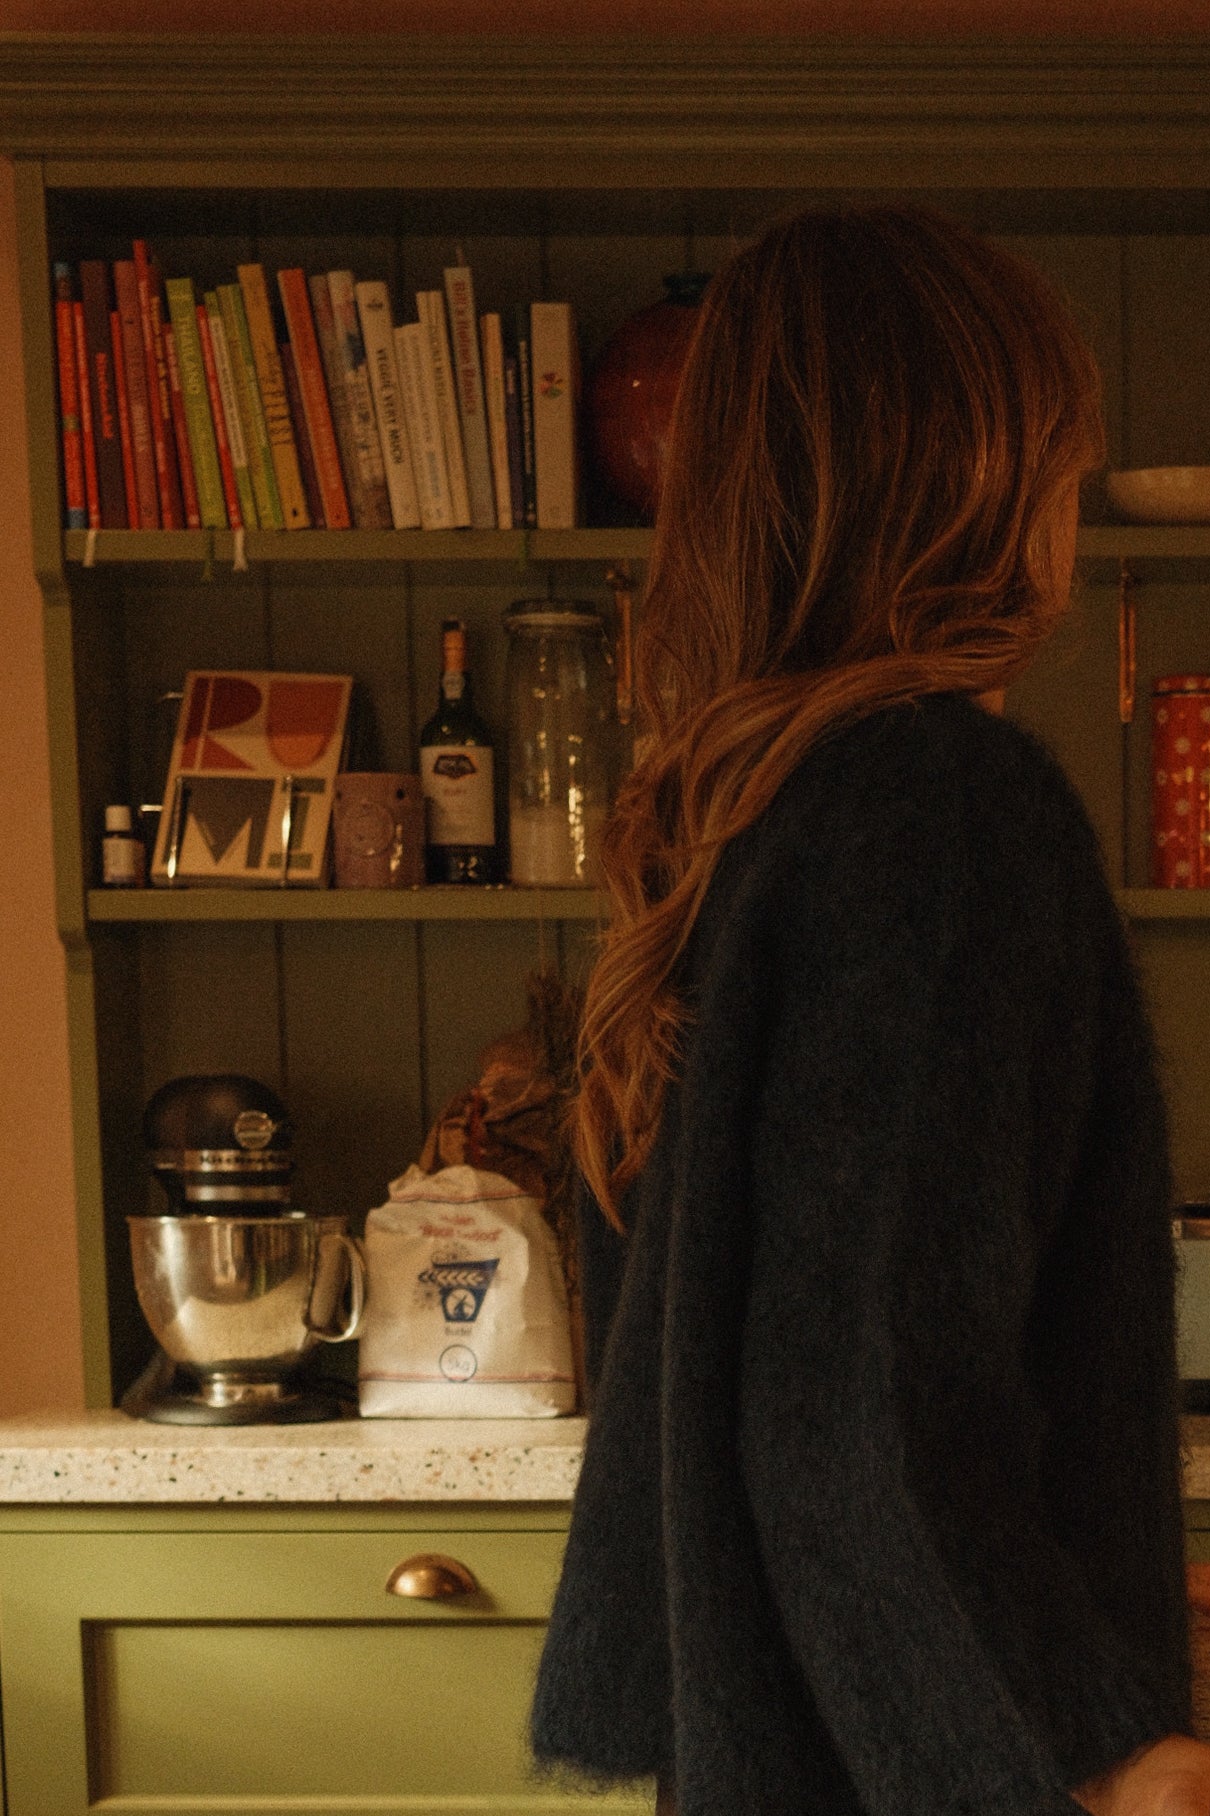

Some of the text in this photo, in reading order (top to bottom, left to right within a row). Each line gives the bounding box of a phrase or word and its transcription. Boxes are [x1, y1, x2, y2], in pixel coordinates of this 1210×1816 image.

[179, 315, 200, 395] THAILAND
[376, 347, 405, 464] VEGGIE VERY MUCH
